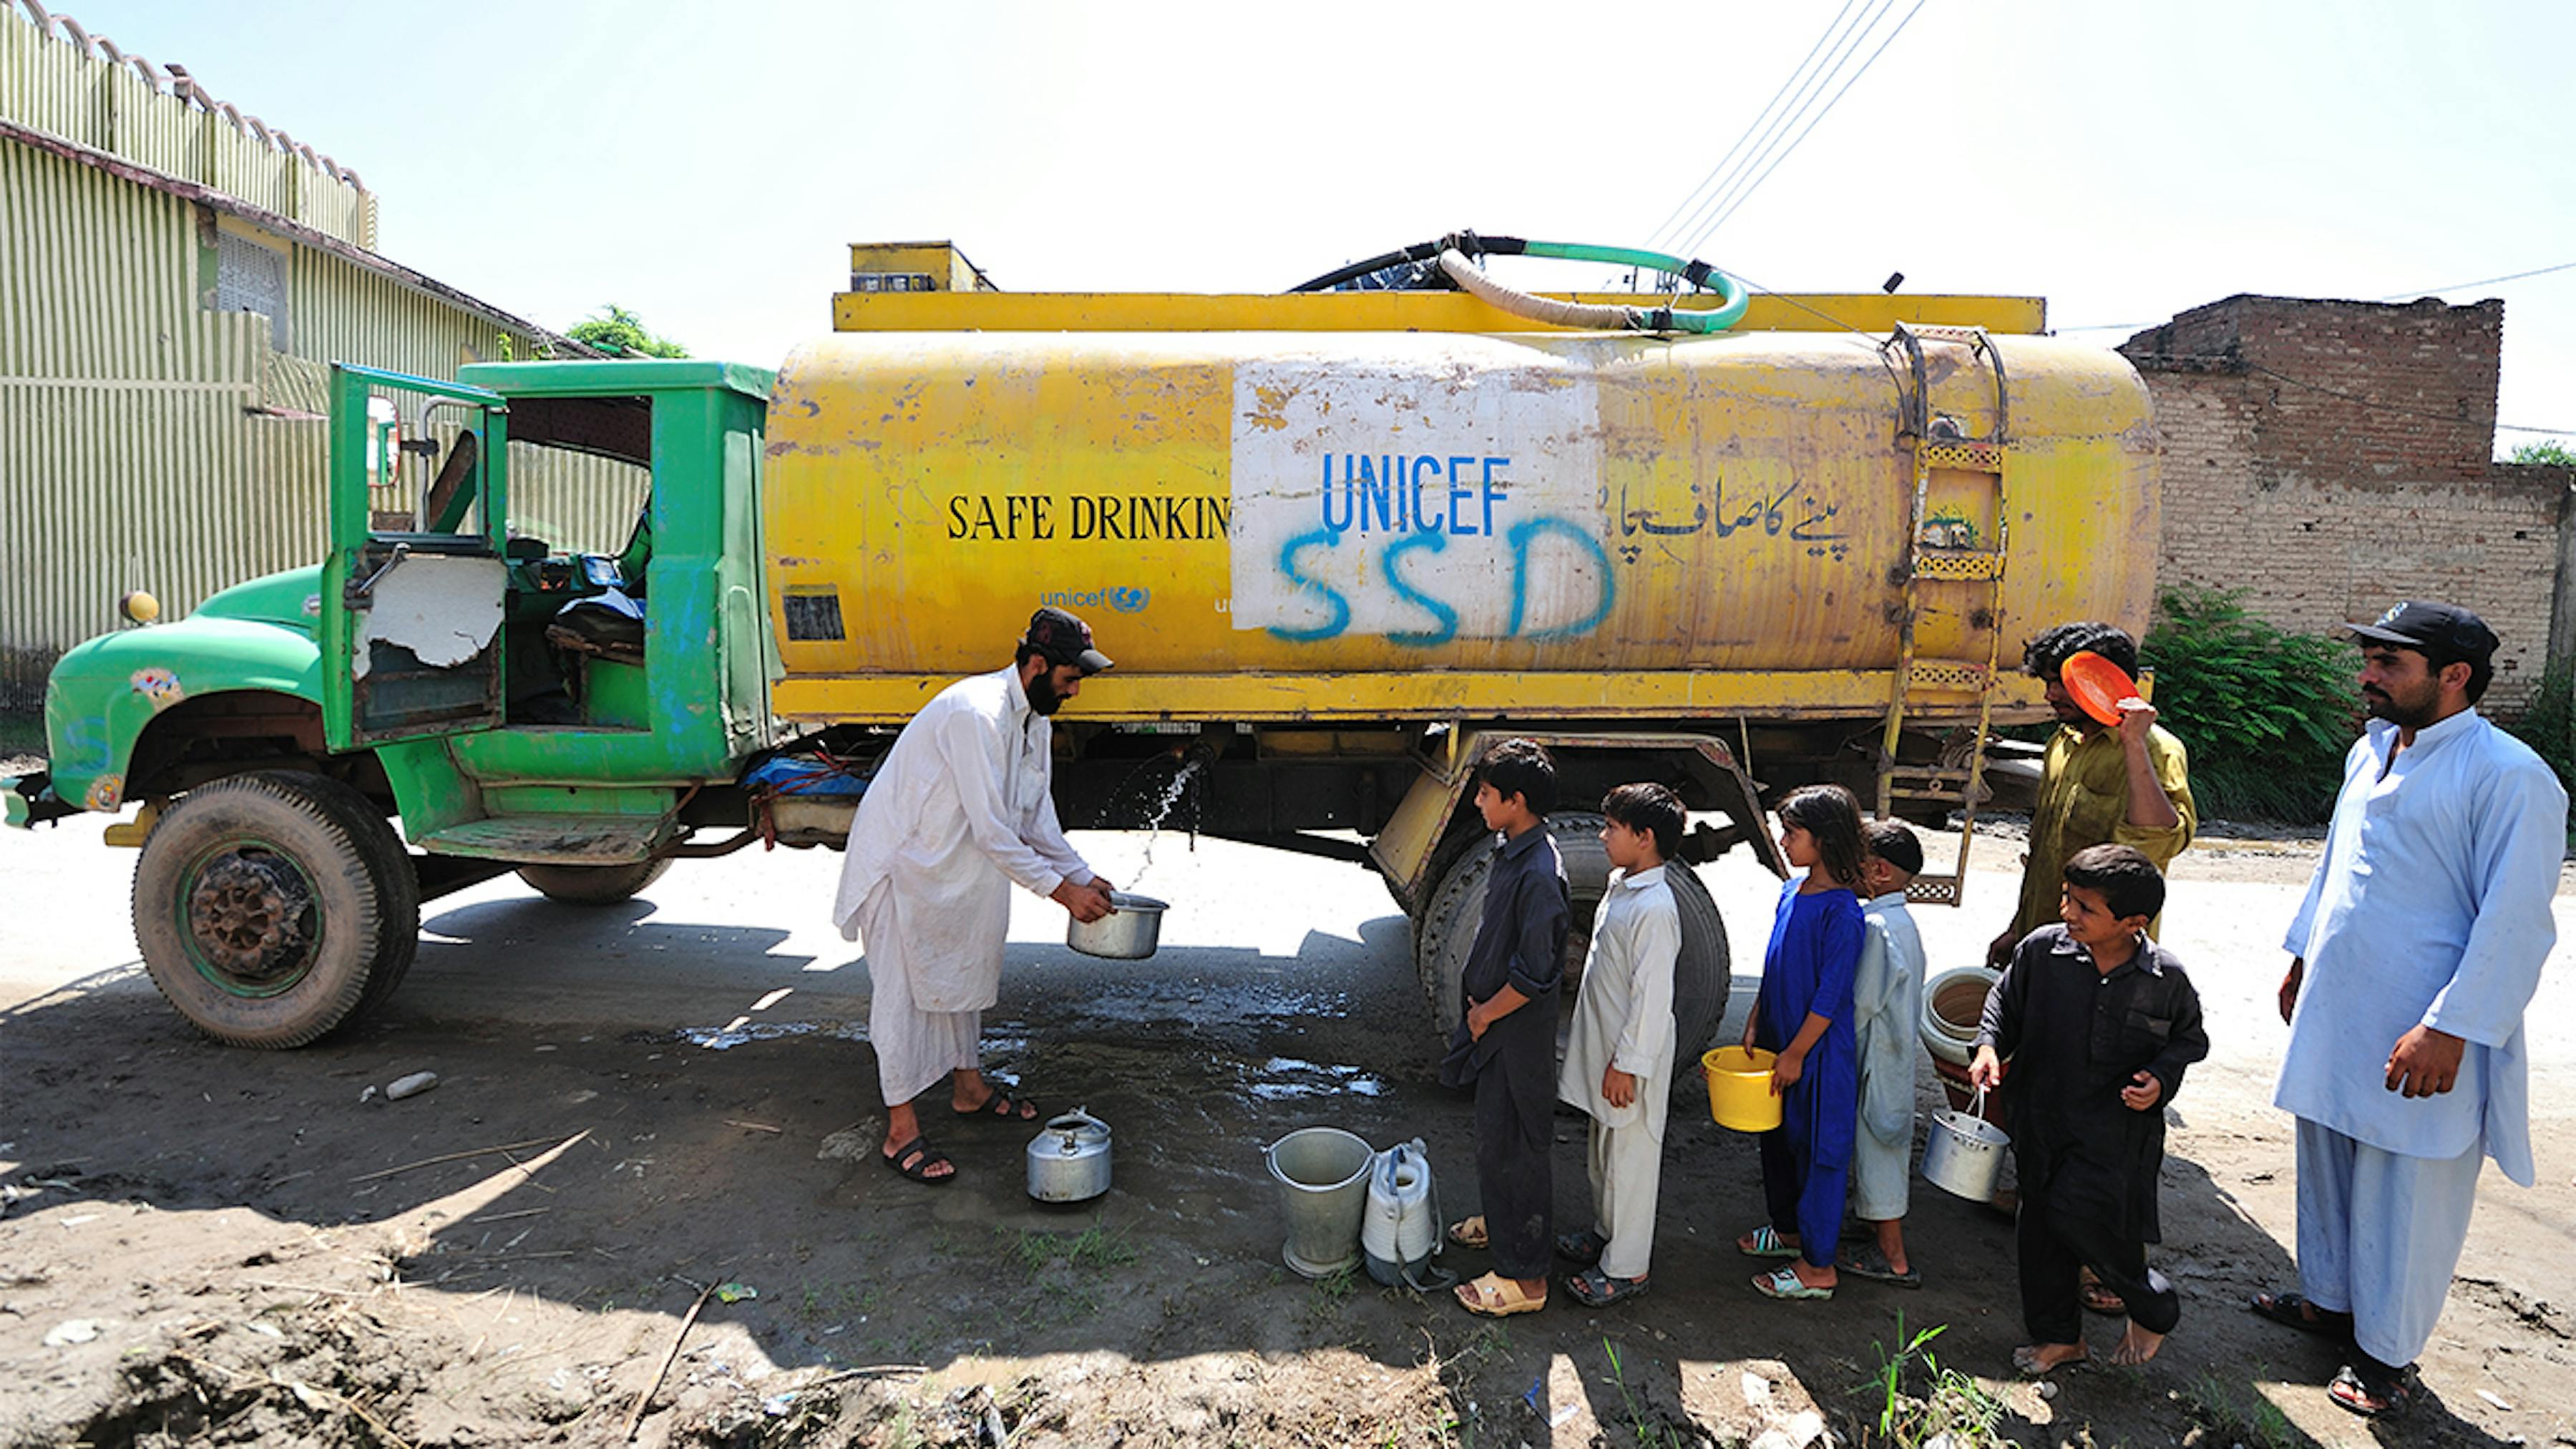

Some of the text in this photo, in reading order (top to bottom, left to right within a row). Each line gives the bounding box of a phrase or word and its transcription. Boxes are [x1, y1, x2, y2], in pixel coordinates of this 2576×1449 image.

[947, 495, 1231, 541] SAFE DRINKIN
[1322, 453, 1510, 536] UNICEF
[1040, 587, 1106, 608] unicef
[1264, 515, 1616, 648] SSD
